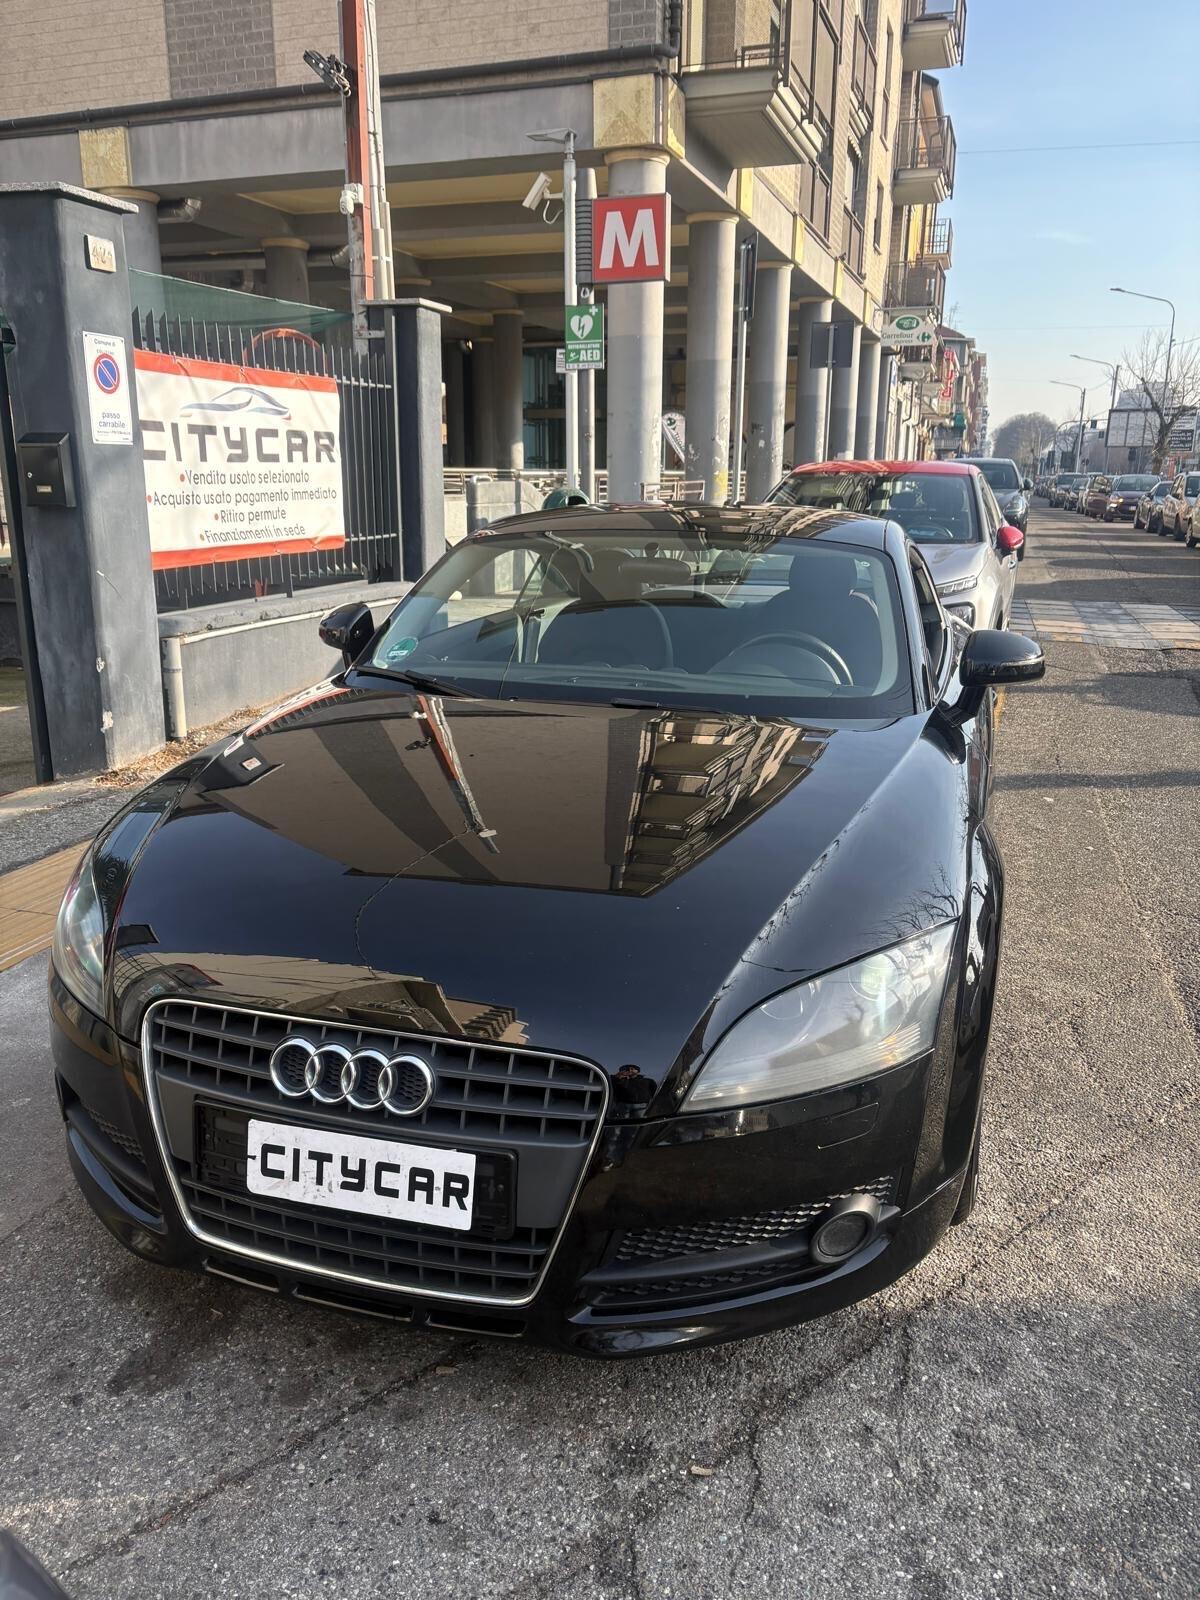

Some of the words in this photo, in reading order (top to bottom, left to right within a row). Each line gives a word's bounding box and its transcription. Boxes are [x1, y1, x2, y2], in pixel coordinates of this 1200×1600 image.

[599, 208, 659, 269] M
[579, 349, 601, 362] AED
[98, 420, 126, 429] carrabile
[102, 411, 120, 420] passo
[185, 470, 227, 485] Vendita
[230, 470, 256, 485] usato
[258, 470, 310, 485] selezionato
[153, 490, 202, 508] Acquisto
[204, 490, 232, 505] usato
[235, 490, 289, 507] pagamento
[291, 487, 337, 501] immediato
[220, 509, 245, 524] Ritiro
[248, 507, 287, 525] permute
[204, 527, 272, 544] Finanziamenti
[273, 526, 283, 537] in
[284, 524, 306, 537] sede
[260, 1143, 470, 1211] CITYCAR
